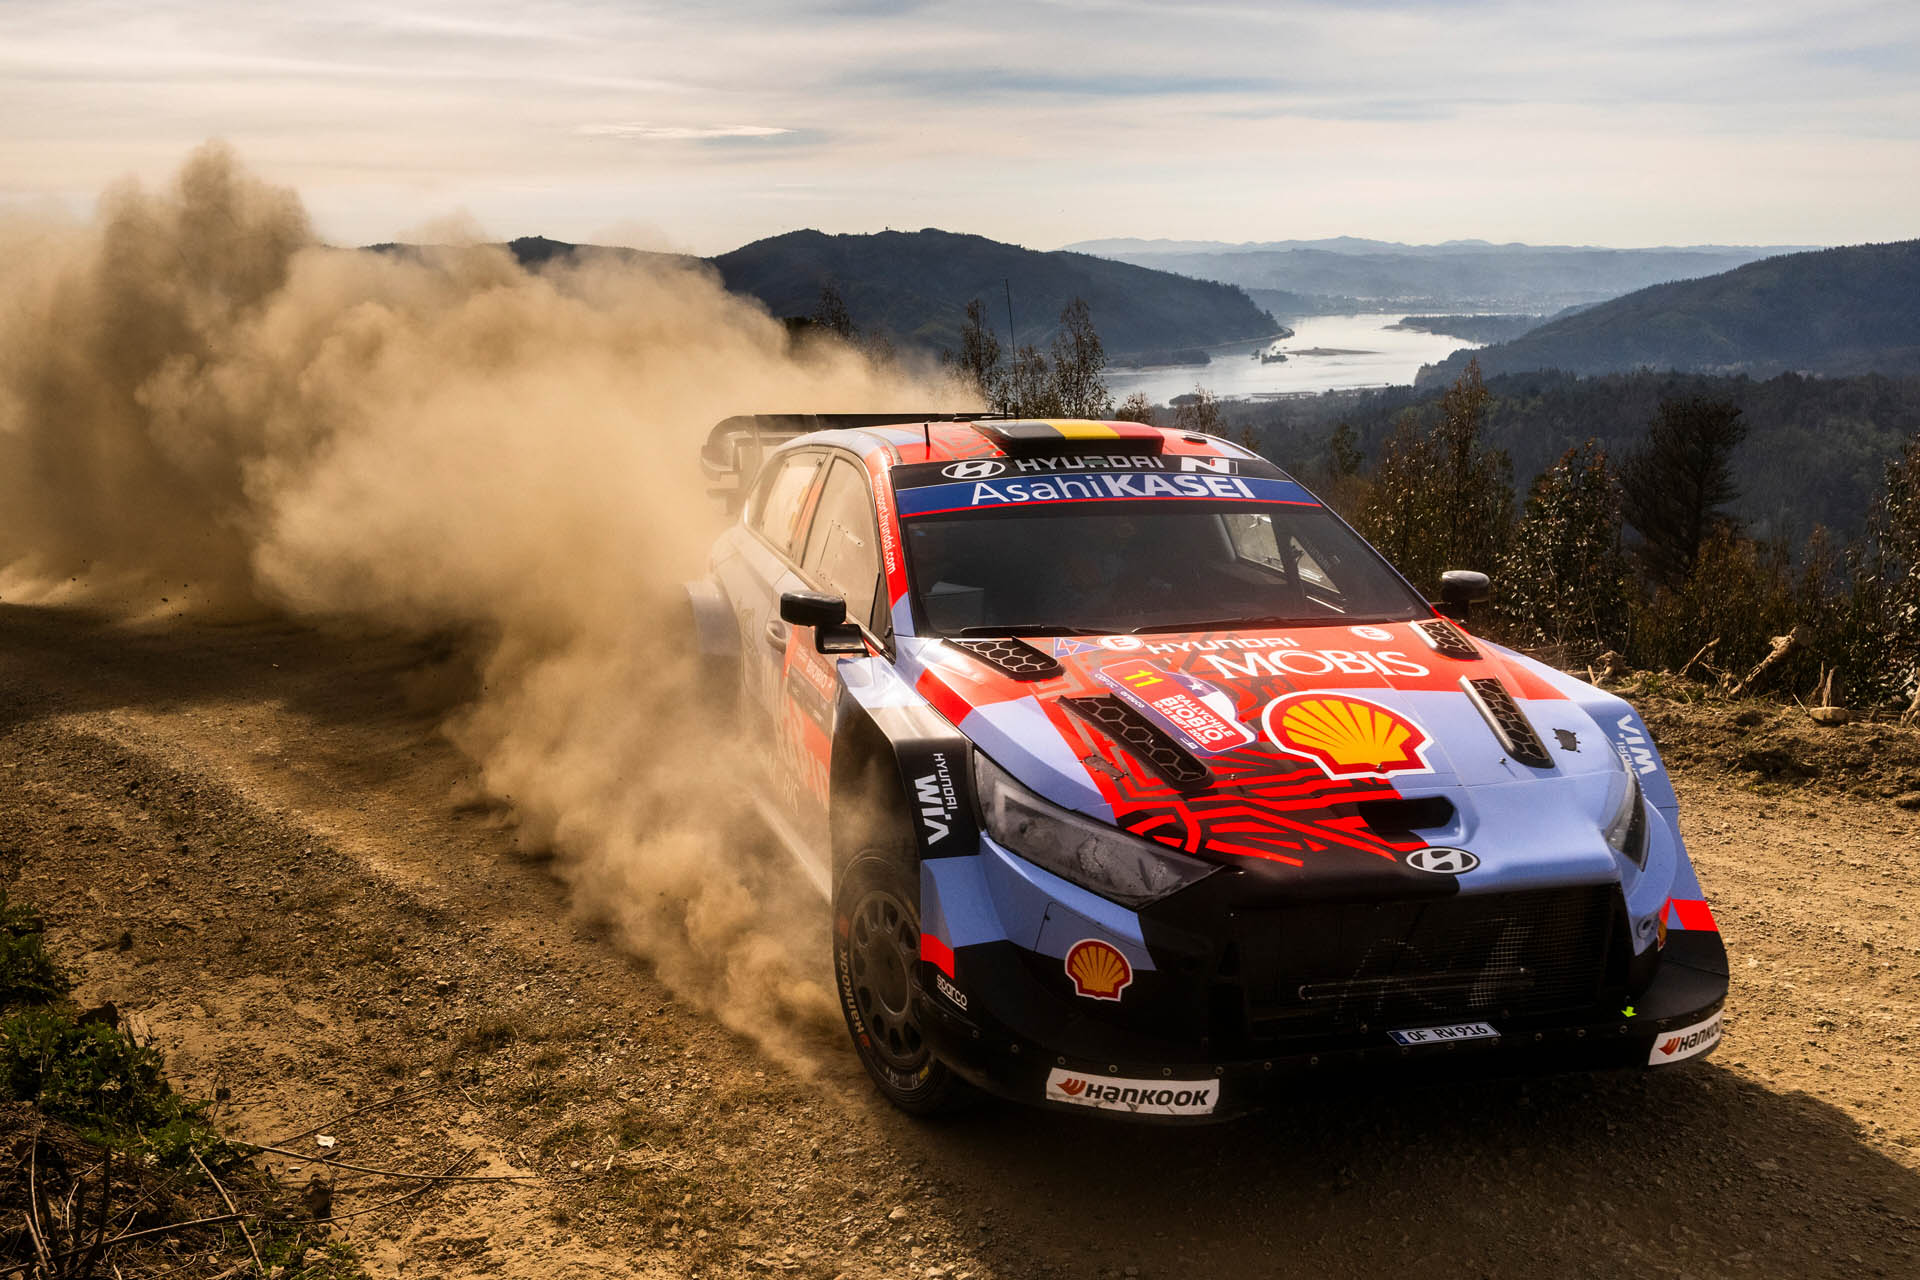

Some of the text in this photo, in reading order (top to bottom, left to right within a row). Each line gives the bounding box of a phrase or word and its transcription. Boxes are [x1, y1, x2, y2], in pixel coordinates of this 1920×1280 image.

[1014, 455, 1238, 475] HYUNDAI N
[1145, 637, 1300, 655] HYUNDAI
[1200, 650, 1430, 679] MOBIS
[1124, 670, 1164, 688] 11
[1169, 714, 1193, 729] SEPT
[933, 753, 958, 810] HYUNDAI
[937, 974, 968, 1008] sparco
[1407, 1030, 1428, 1041] OF
